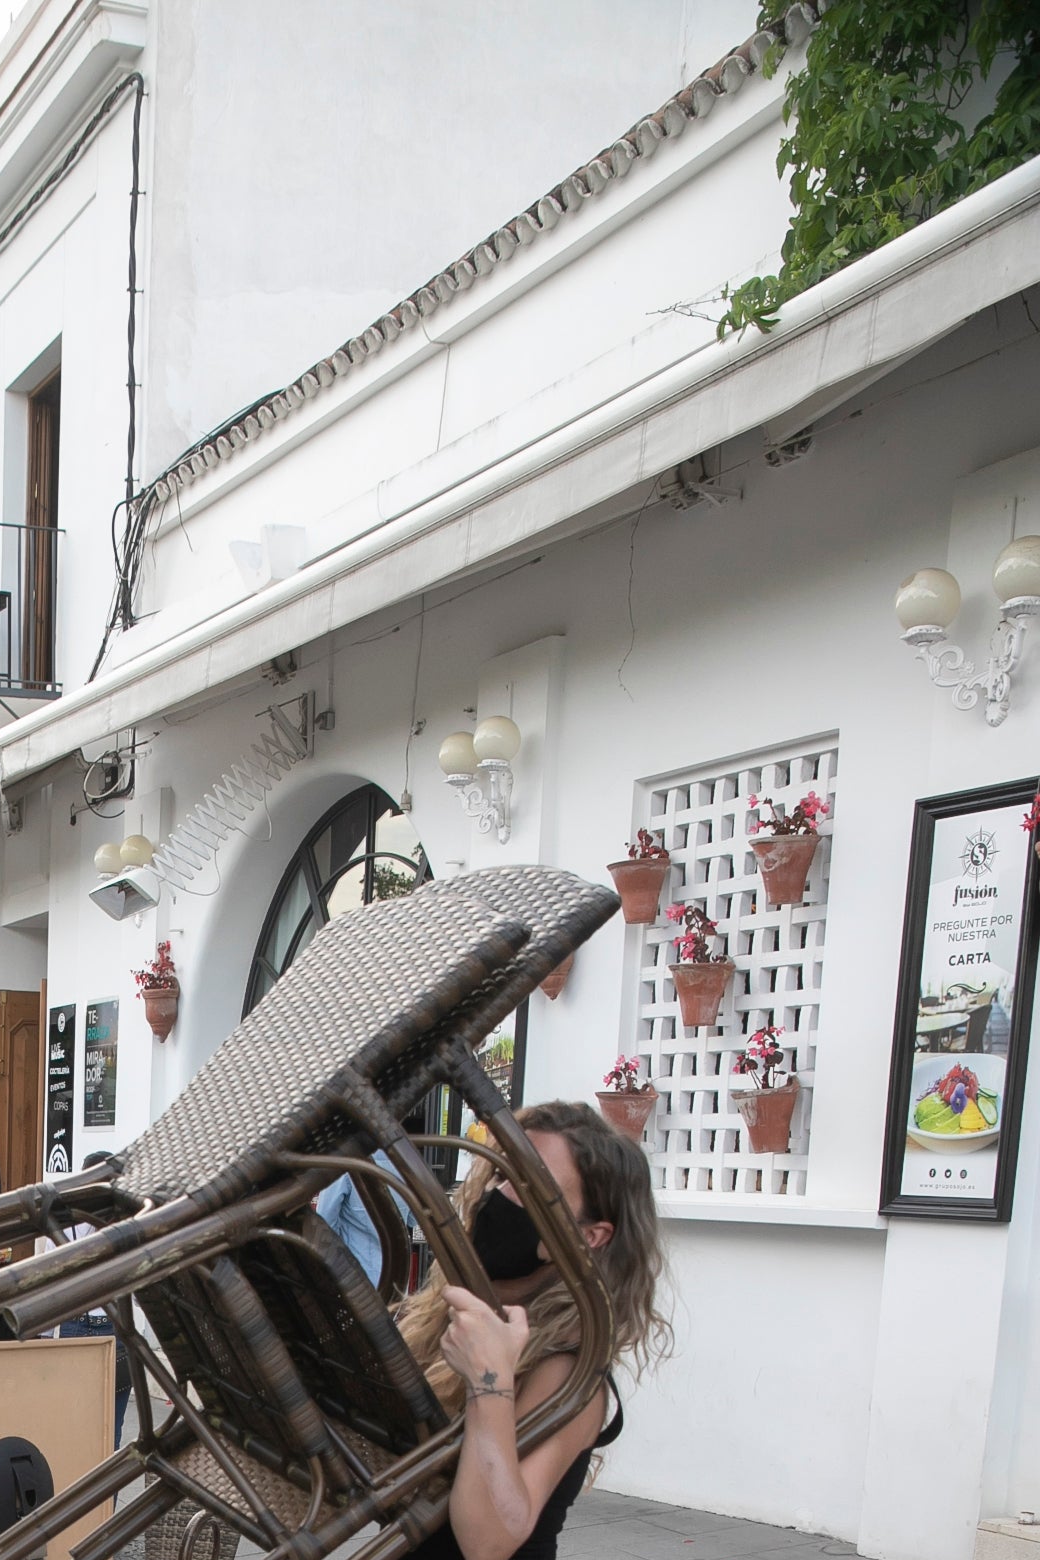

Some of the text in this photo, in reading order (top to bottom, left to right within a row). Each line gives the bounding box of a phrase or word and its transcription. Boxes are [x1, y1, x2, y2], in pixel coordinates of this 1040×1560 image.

[933, 914, 1013, 932] PREGUNTE POR
[948, 929, 997, 943] NUESTRA
[949, 952, 991, 966] CARTA
[53, 1101, 69, 1111] COPAS
